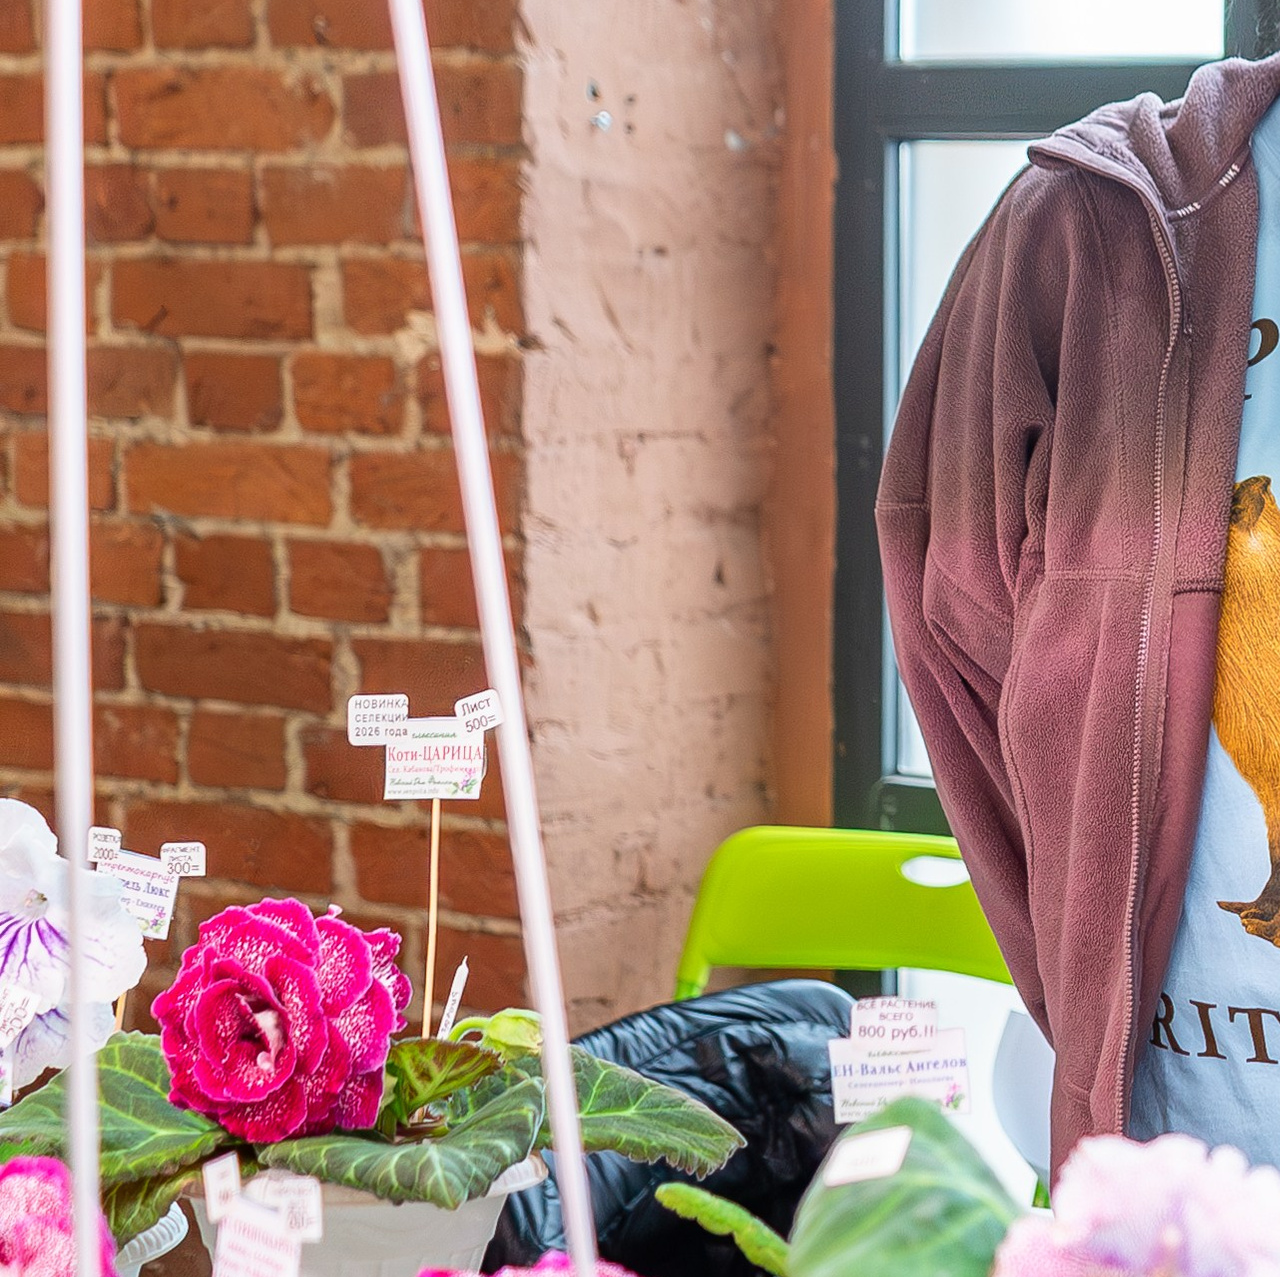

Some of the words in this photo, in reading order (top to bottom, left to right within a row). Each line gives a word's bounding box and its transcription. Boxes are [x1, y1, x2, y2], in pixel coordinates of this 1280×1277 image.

[354, 698, 408, 709] НОВИНКА
[461, 697, 491, 717] Лист
[354, 713, 408, 723] СЕЛЕКЦИИ
[465, 714, 496, 733] 500=
[355, 726, 380, 737] 2026
[384, 727, 408, 738] года
[387, 745, 483, 762] Коти-ЦАРИЦА
[167, 862, 200, 875] 300=
[880, 999, 937, 1010] РАСТЕНИЕ
[879, 1012, 914, 1021] ВСЕГО
[858, 1025, 886, 1038] 800
[906, 1058, 968, 1074] Ангелов
